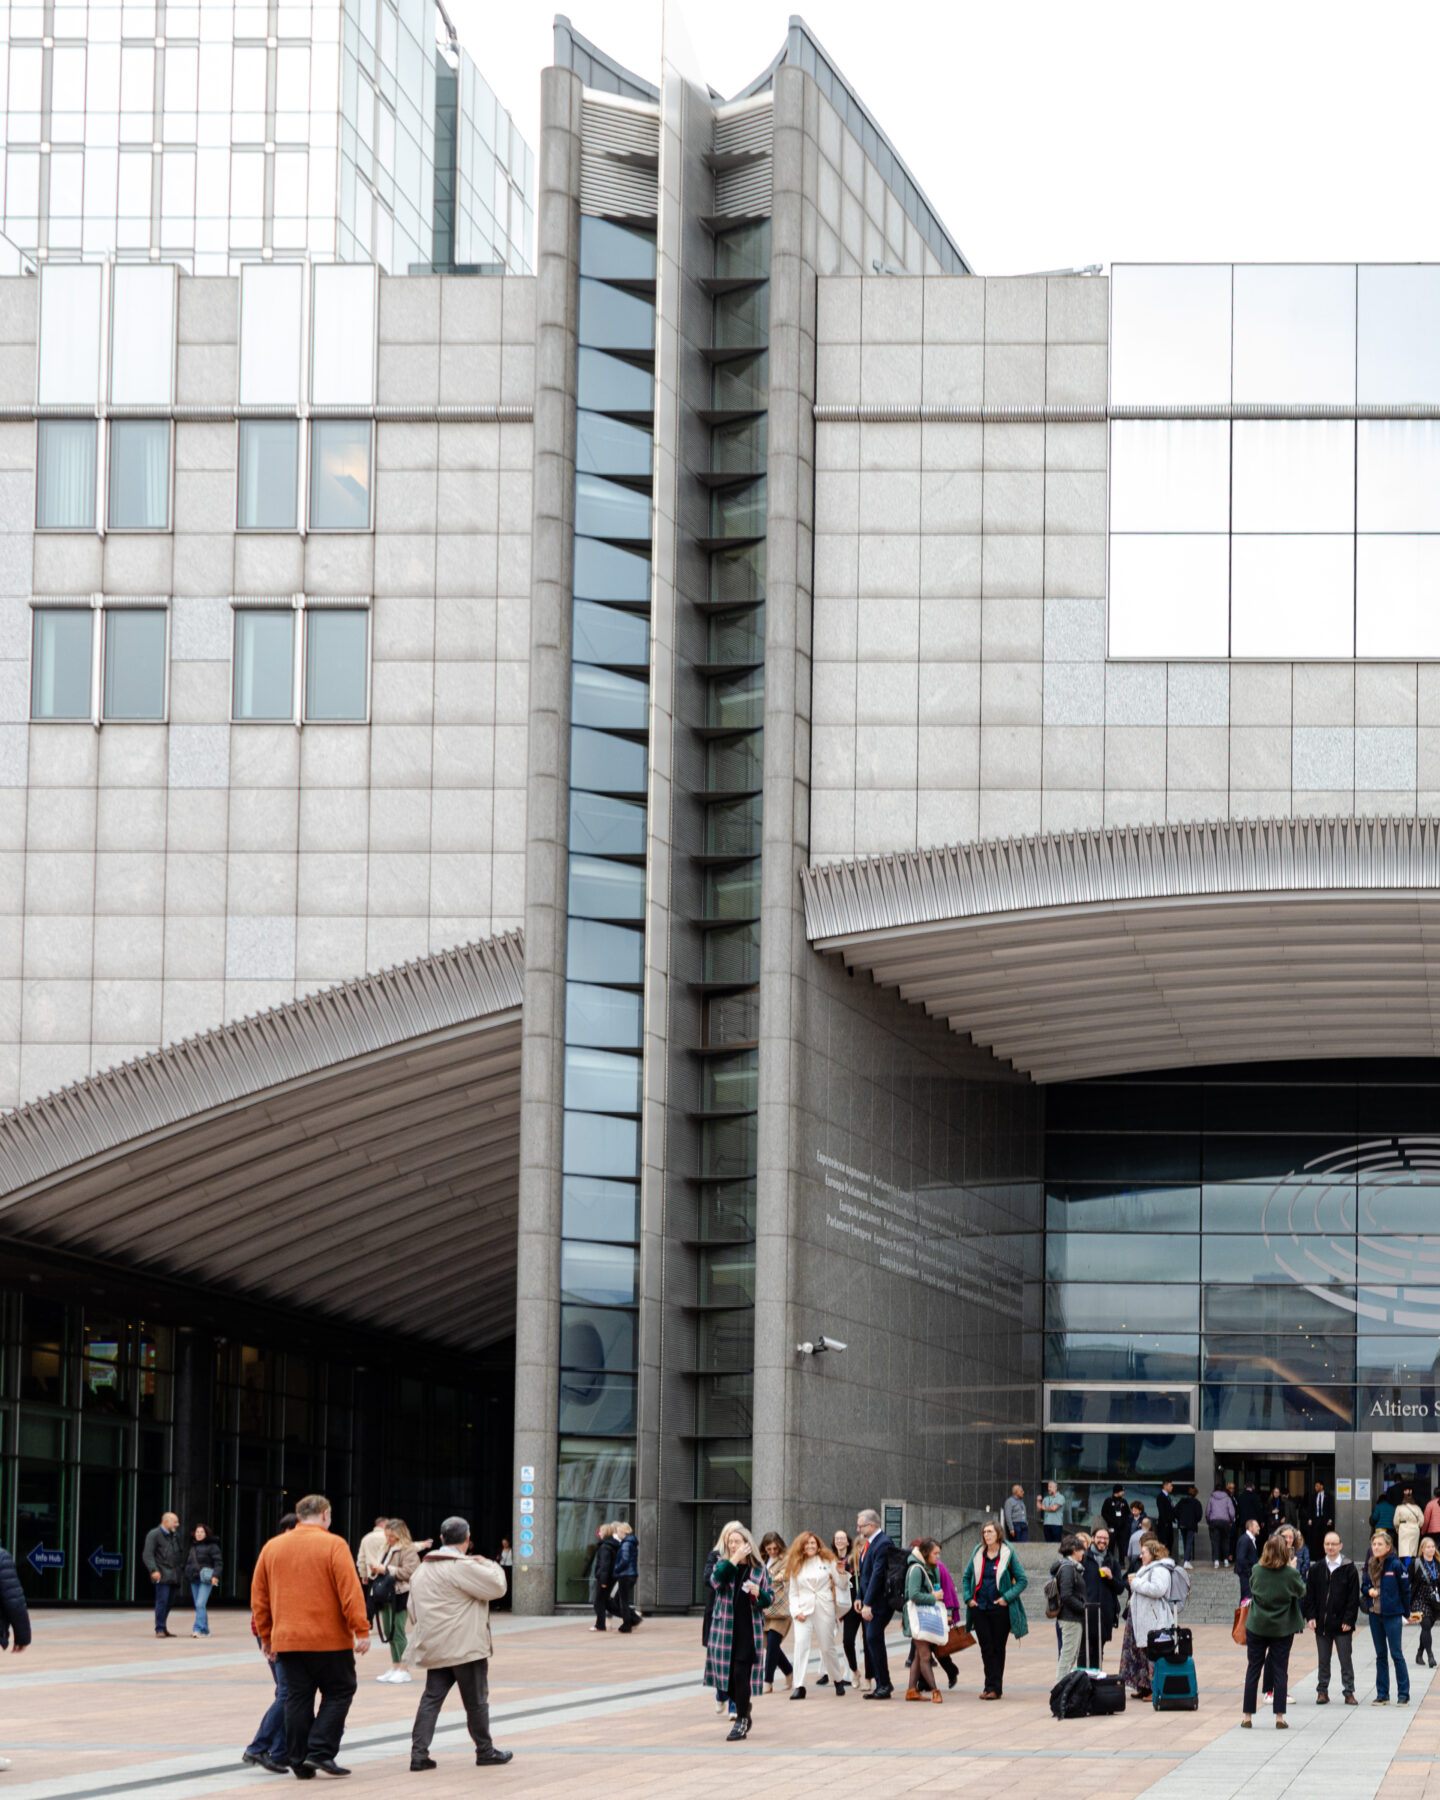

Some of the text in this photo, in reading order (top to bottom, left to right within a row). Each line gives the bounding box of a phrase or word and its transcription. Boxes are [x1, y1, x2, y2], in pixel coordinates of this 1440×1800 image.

[1370, 1400, 1428, 1417] Altiero
[35, 1554, 61, 1563] Info Hub
[95, 1556, 119, 1565] Entrance
